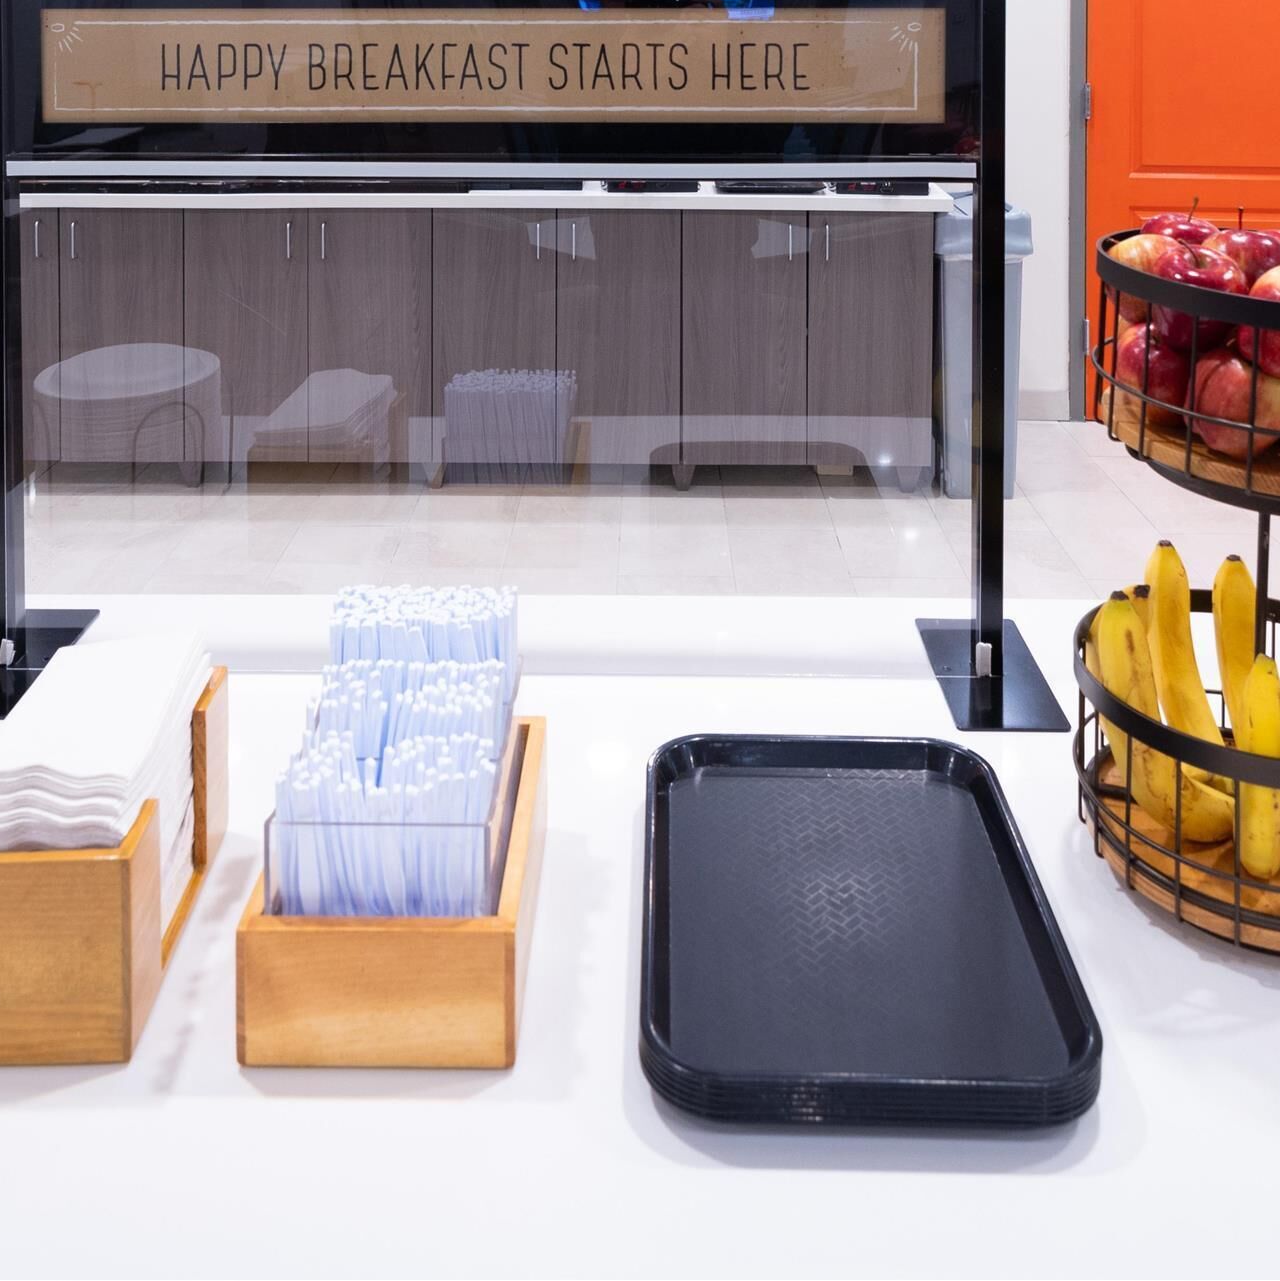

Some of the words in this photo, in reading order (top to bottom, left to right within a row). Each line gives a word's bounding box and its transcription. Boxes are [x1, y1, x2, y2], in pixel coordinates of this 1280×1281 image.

[161, 43, 288, 91] HAPPY
[308, 43, 530, 91] BREAKFAST
[548, 42, 688, 91] STARTS
[711, 42, 811, 91] HERE
